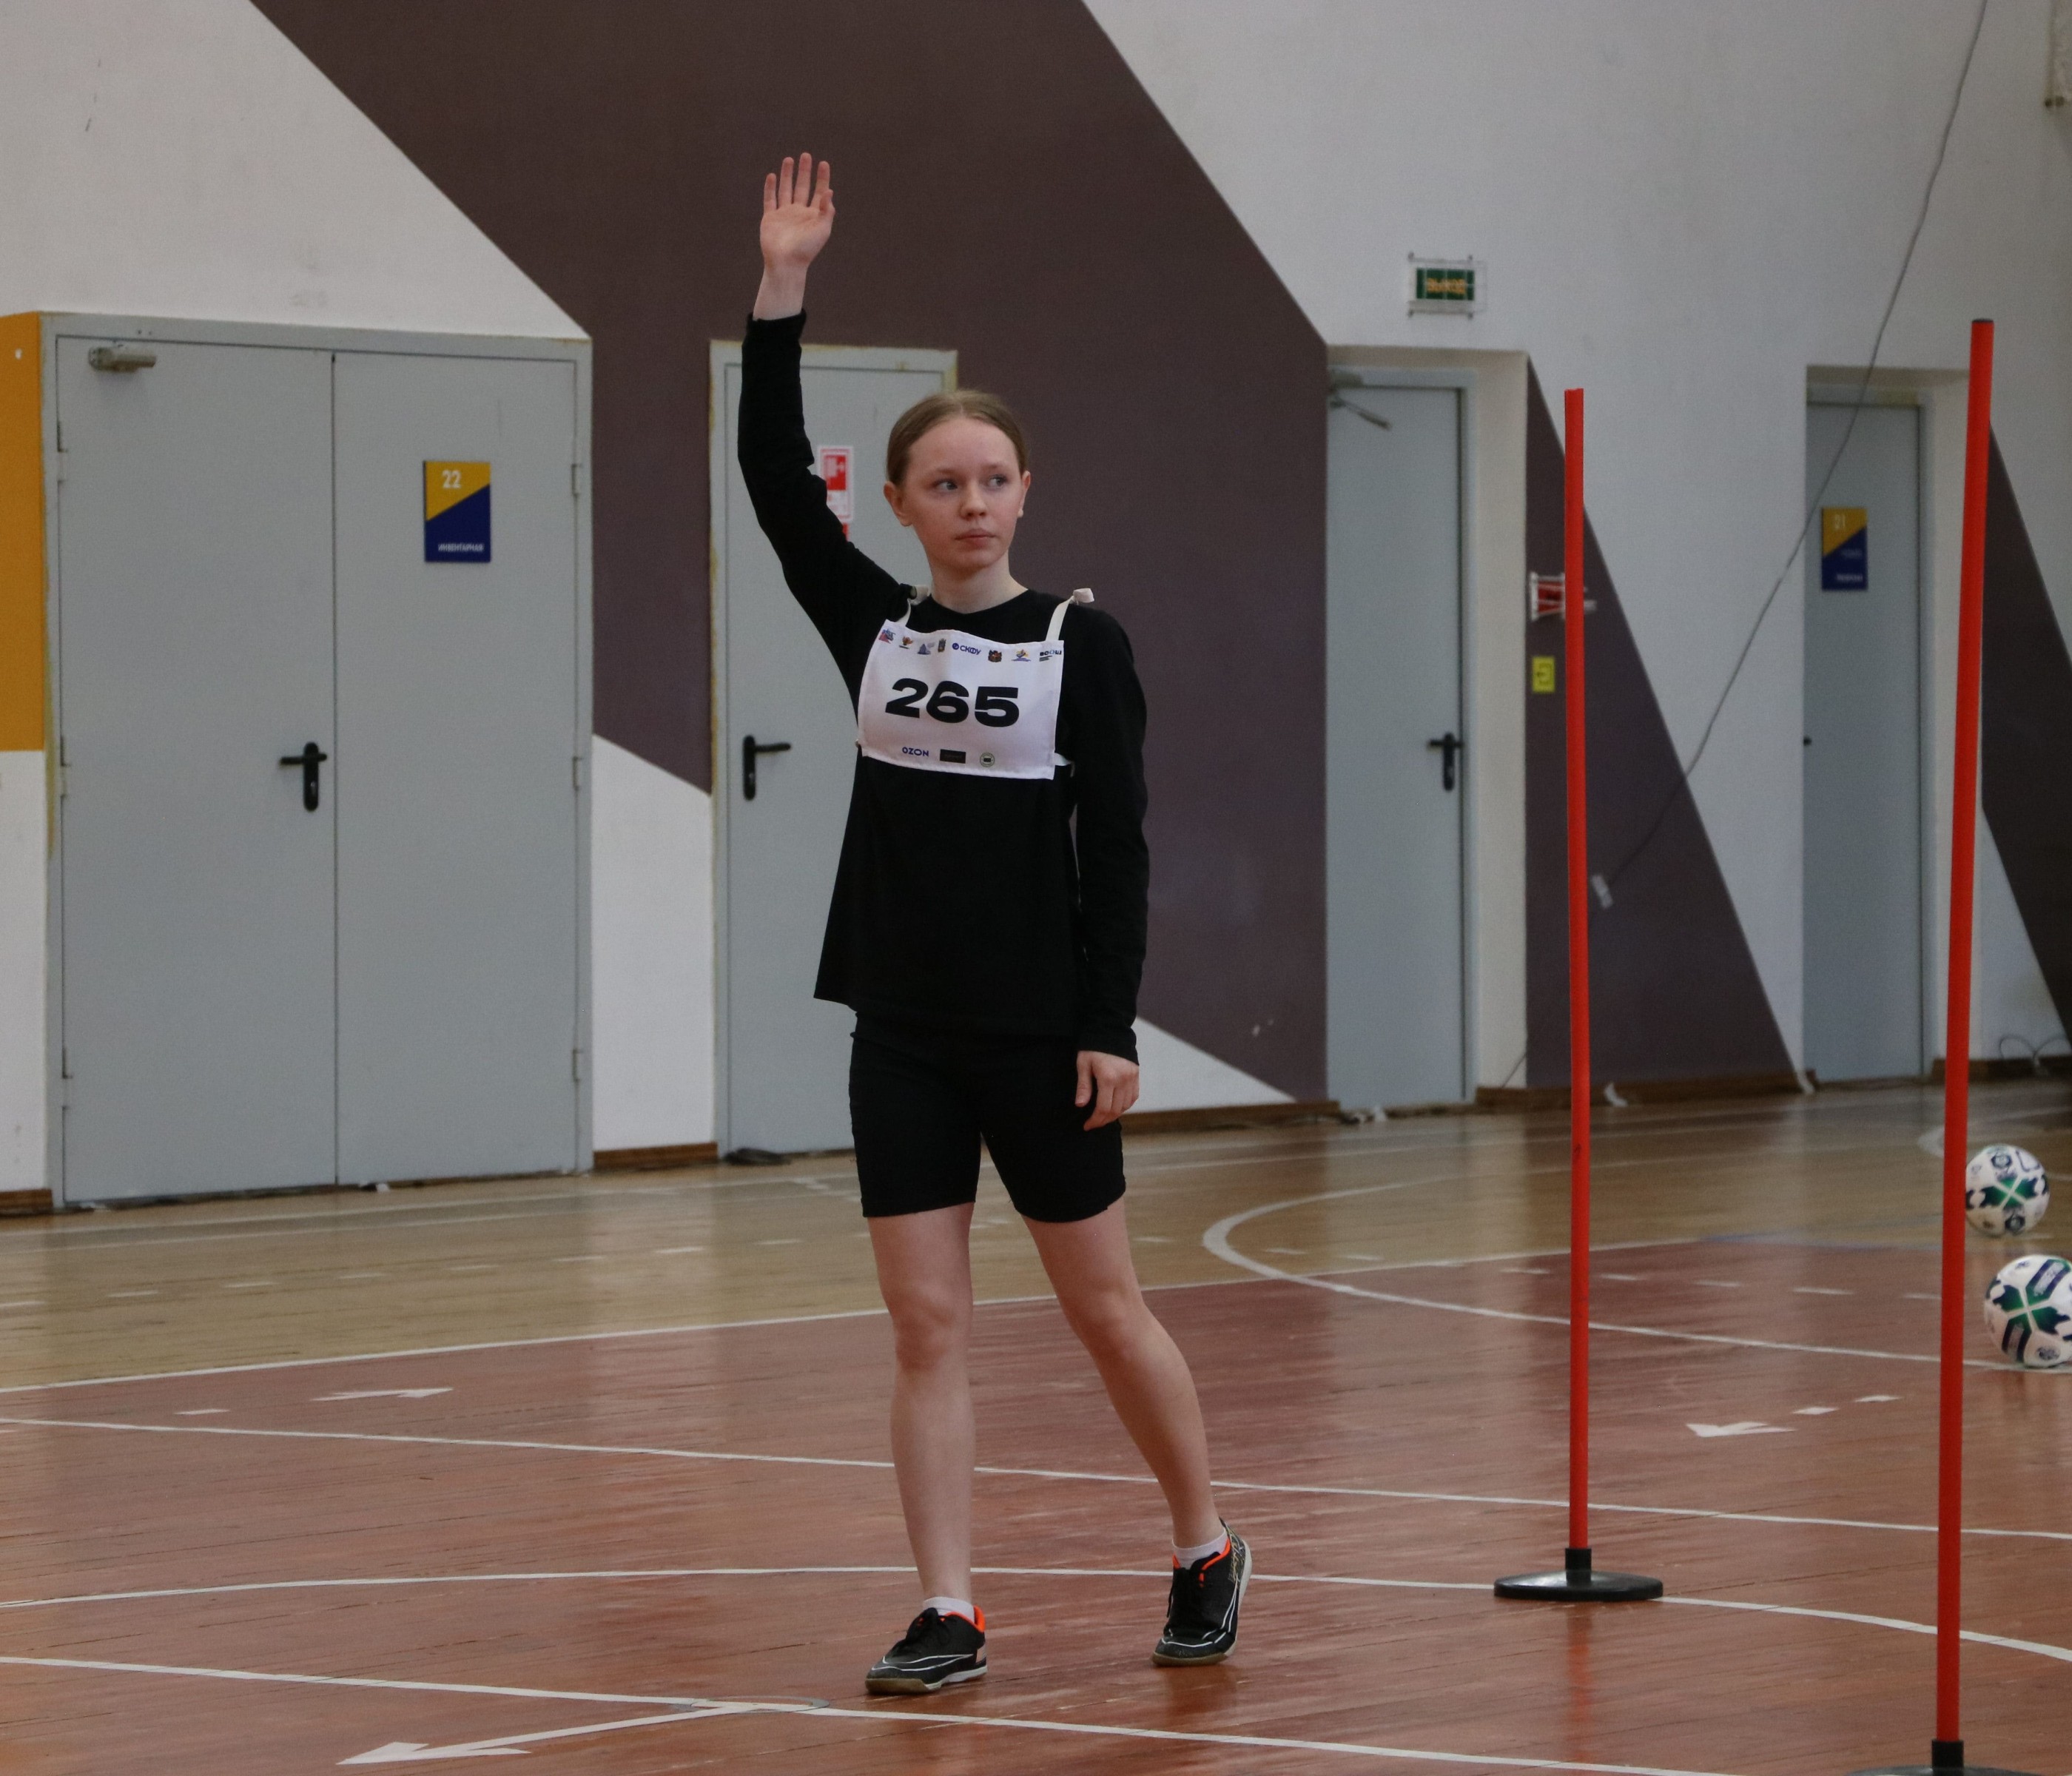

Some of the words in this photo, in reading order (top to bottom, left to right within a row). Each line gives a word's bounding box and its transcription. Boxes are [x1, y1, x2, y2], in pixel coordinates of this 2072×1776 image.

[442, 469, 460, 488] 22
[960, 645, 981, 655] СКФУ
[885, 678, 1020, 727] 265
[901, 746, 929, 757] OZON
